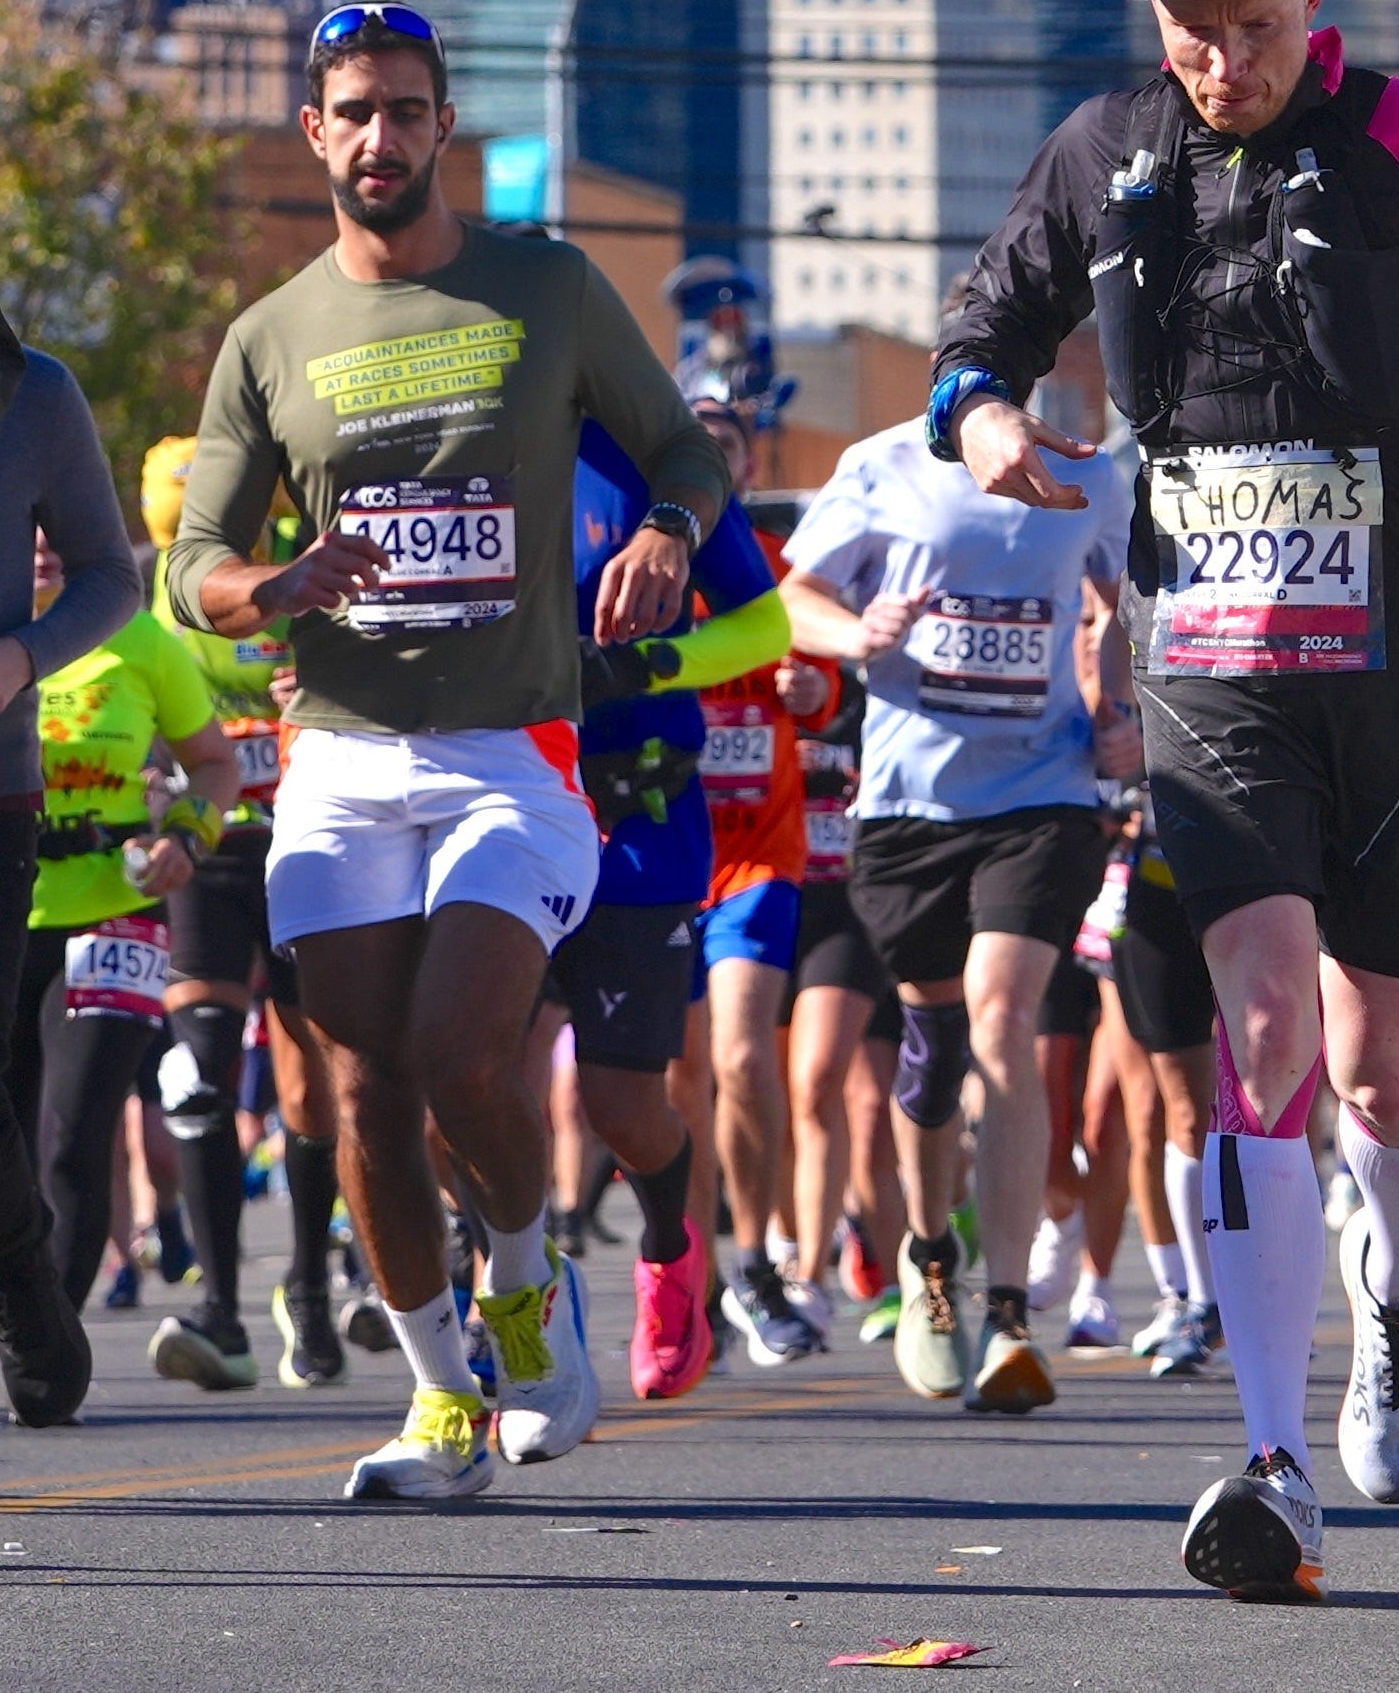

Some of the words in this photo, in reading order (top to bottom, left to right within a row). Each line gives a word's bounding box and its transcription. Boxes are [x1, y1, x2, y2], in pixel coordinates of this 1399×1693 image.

[465, 322, 514, 344] MADE
[325, 377, 342, 392] AT
[349, 363, 403, 386] RACES
[409, 347, 510, 374] SOMETIMES
[341, 390, 382, 409] LAST
[388, 386, 399, 398] A
[336, 419, 368, 437] JOE
[370, 399, 475, 429] KLEINERMAN
[463, 493, 494, 503] TATA
[1161, 479, 1365, 530] THOMAS
[1187, 529, 1355, 585] 22924
[443, 565, 453, 575] A
[1210, 589, 1217, 599] 2
[1277, 589, 1287, 601] D
[464, 603, 497, 615] 2024
[933, 622, 1044, 664] 23885
[1299, 636, 1344, 650] 2024
[1299, 652, 1309, 664] B
